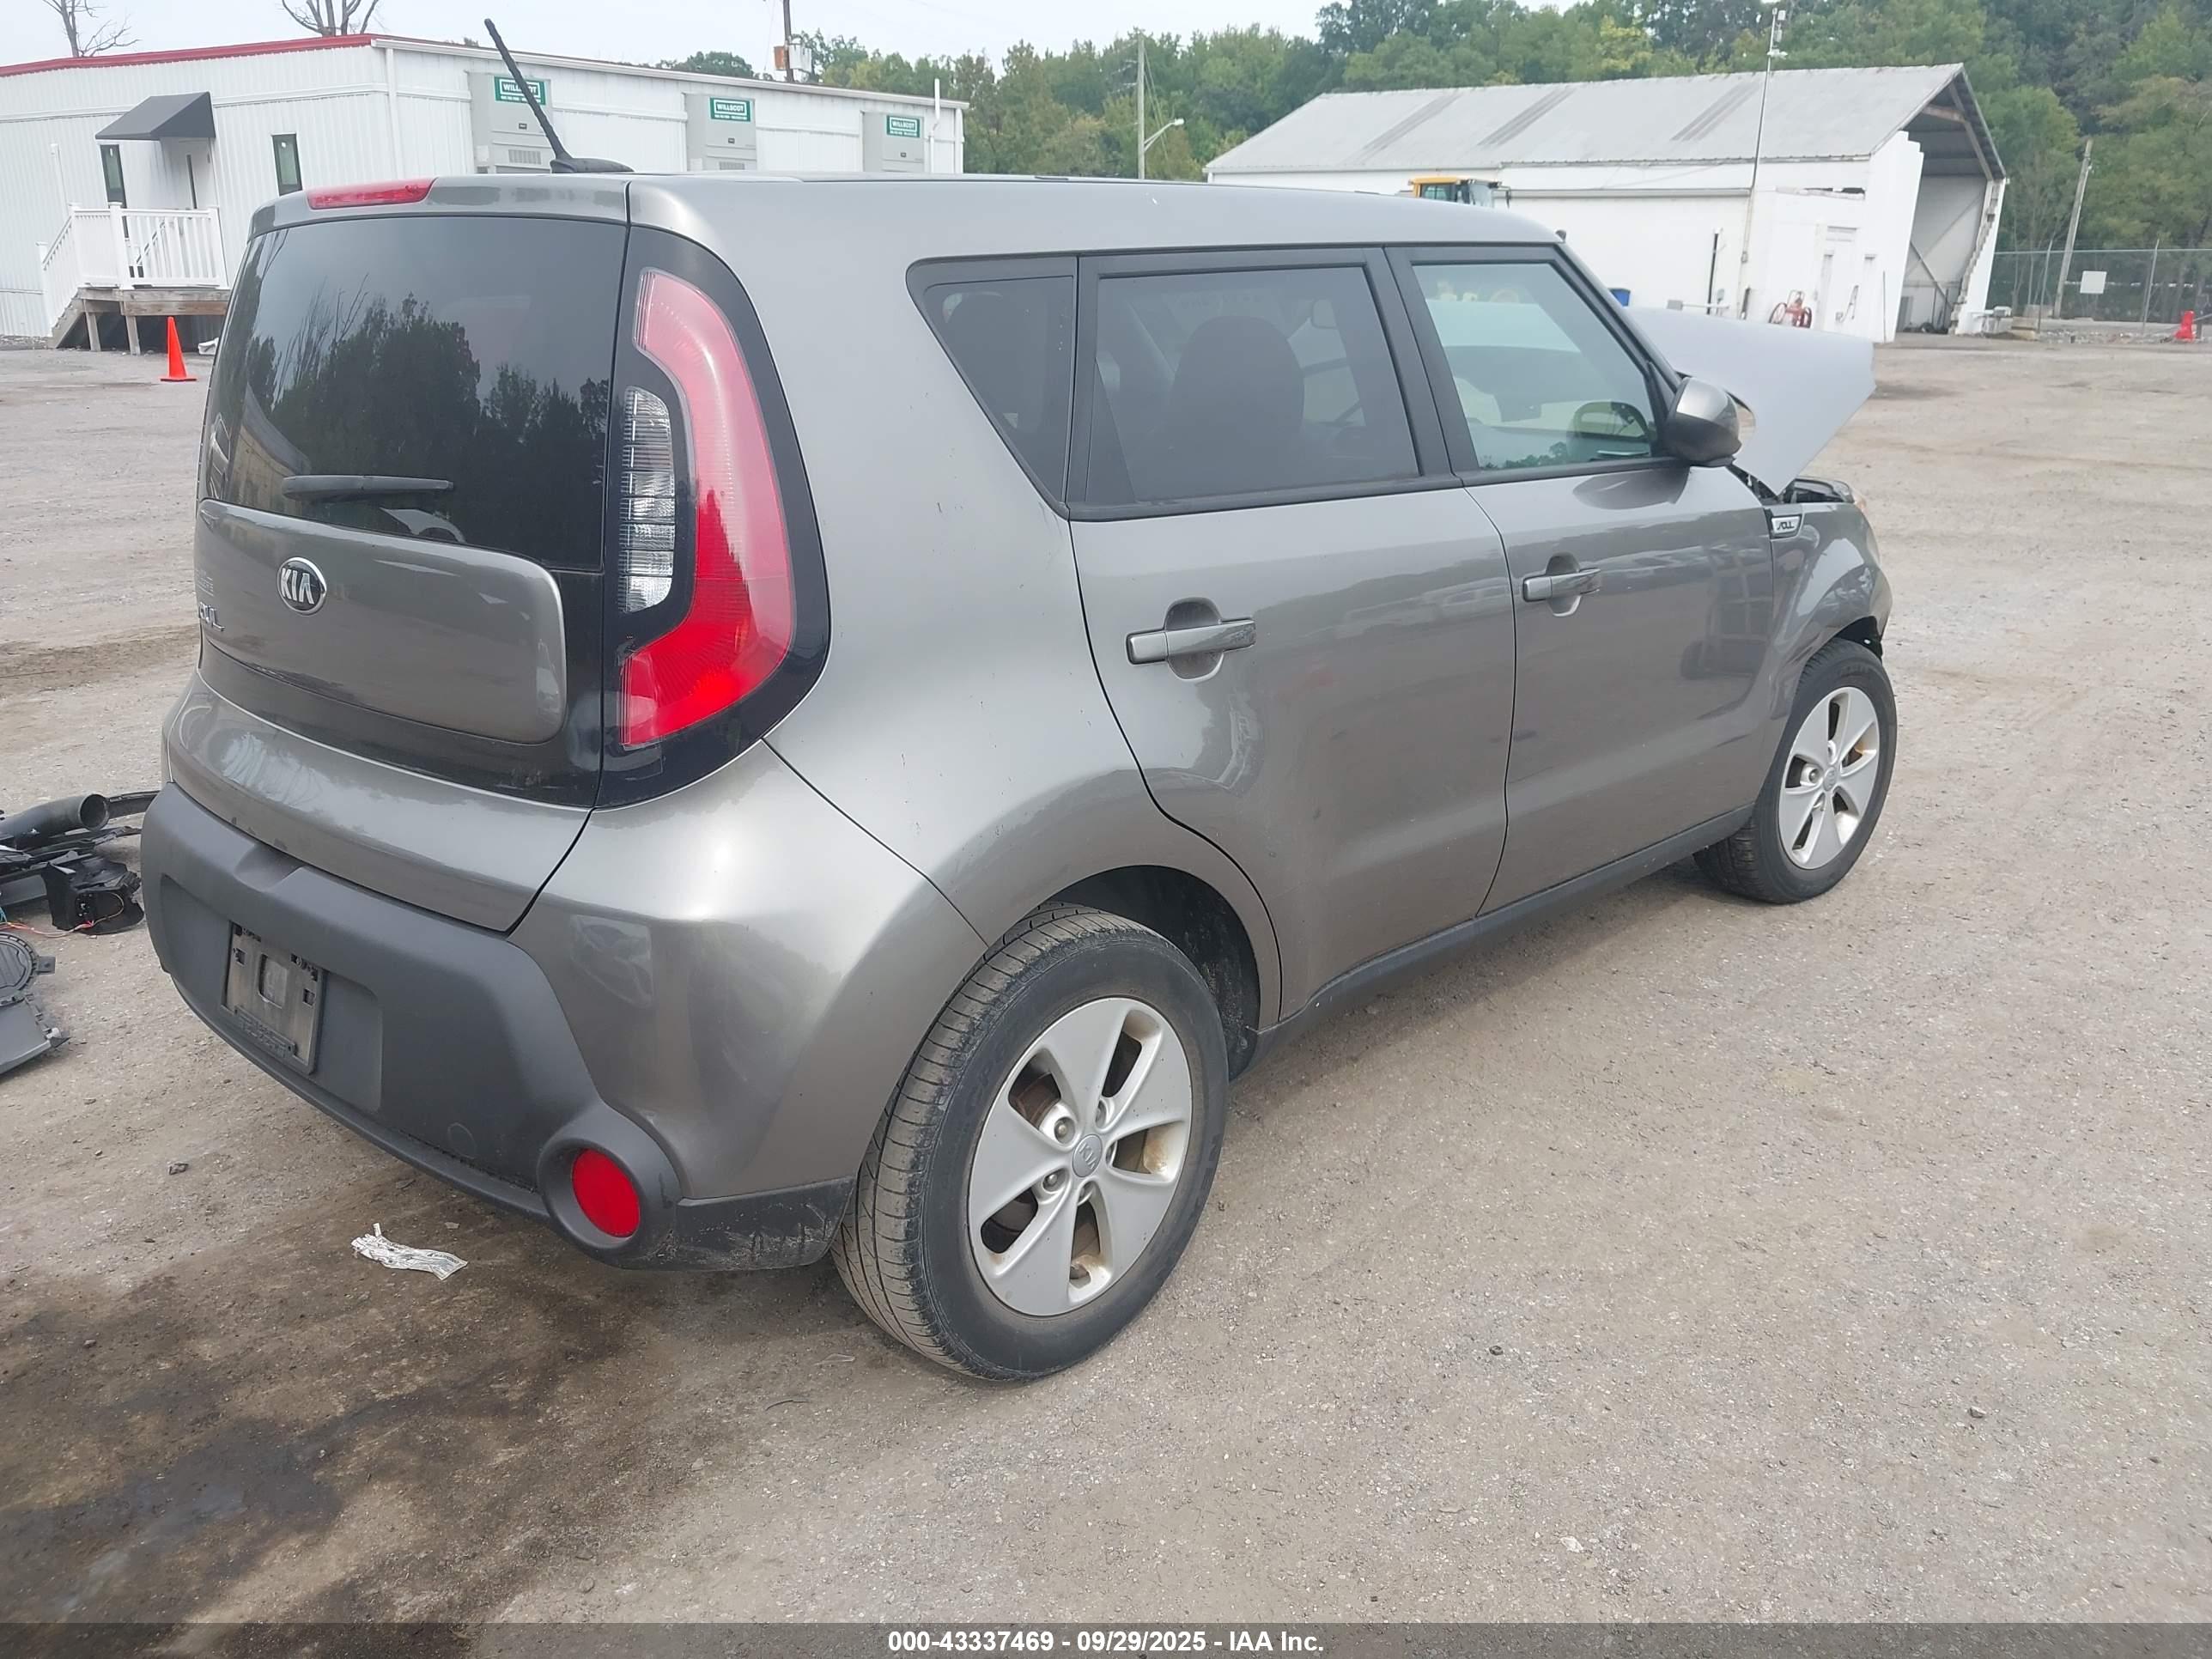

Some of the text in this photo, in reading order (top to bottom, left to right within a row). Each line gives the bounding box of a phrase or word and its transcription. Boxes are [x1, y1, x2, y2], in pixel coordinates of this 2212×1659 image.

[716, 103, 744, 112] WILLSCOT
[280, 567, 315, 605] KIA
[1079, 1142, 1097, 1170] KIA
